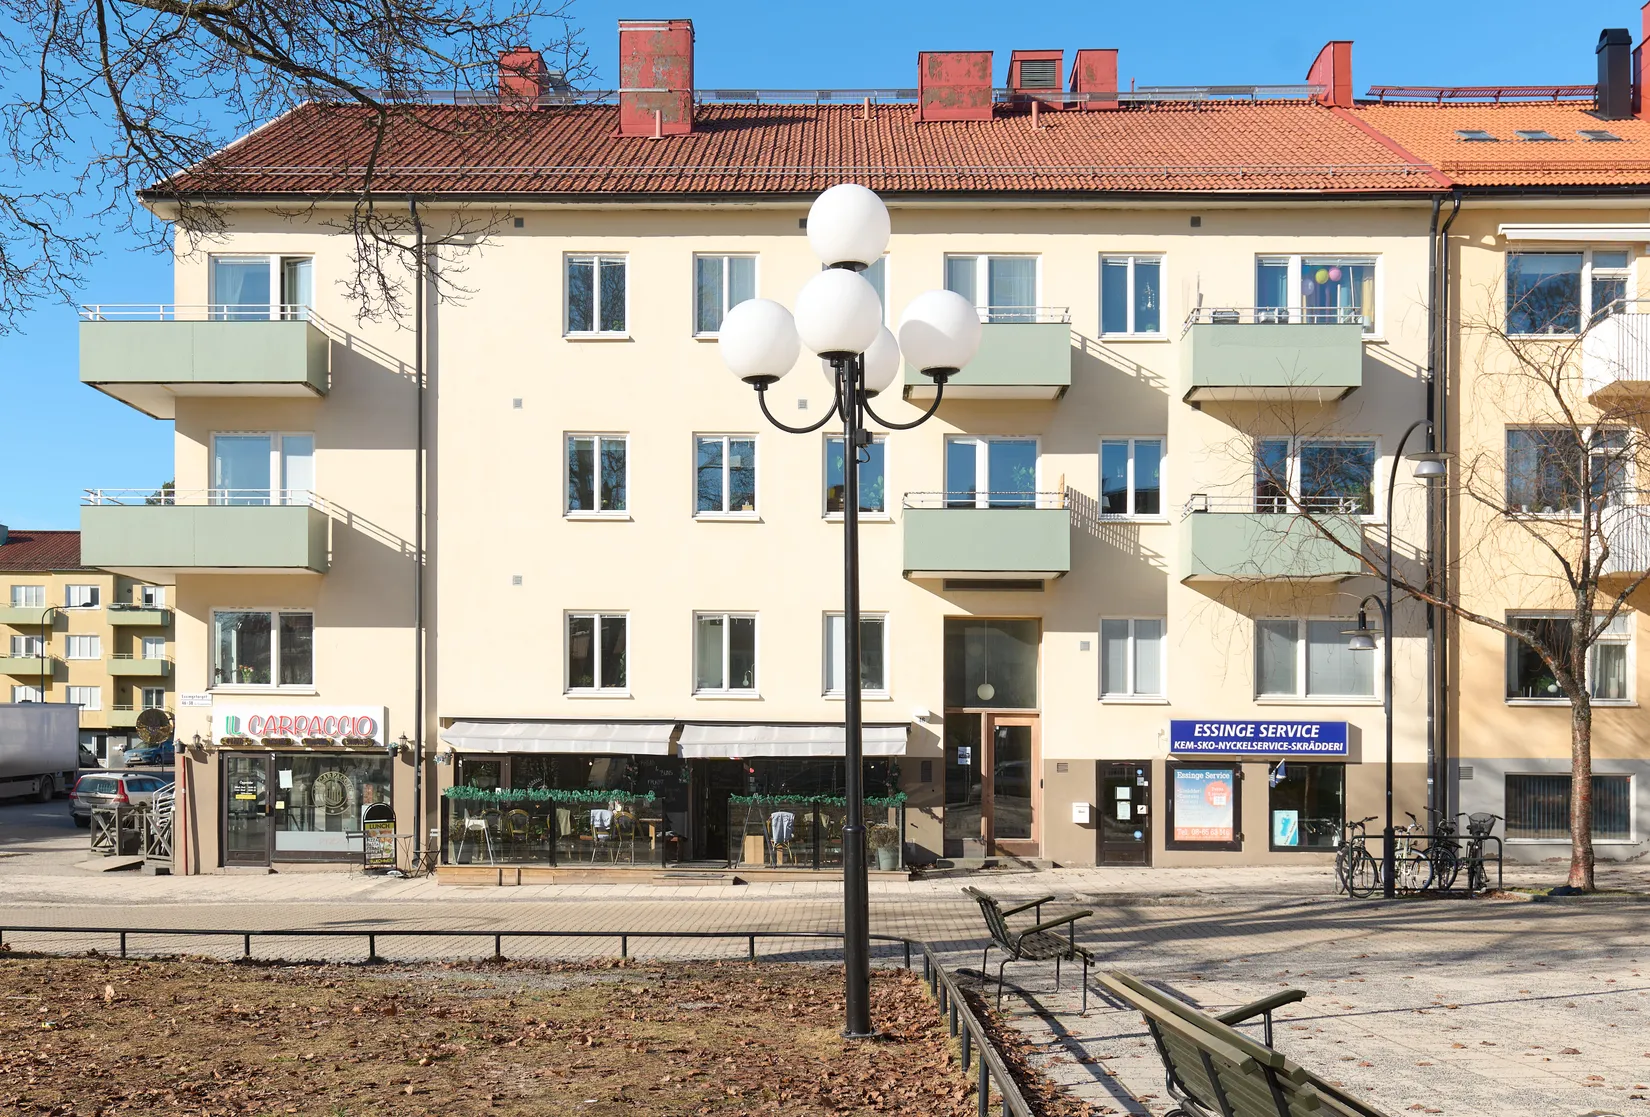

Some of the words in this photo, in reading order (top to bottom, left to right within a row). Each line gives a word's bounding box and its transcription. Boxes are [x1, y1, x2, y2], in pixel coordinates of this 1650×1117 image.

[225, 715, 242, 735] IL
[248, 715, 373, 736] CARPACCIO
[1193, 723, 1256, 738] ESSINGE
[1258, 724, 1320, 738] SERVICE
[1174, 740, 1344, 751] KEM-SKO-NYCKELSERVICE-SKRÄDDERI
[1177, 771, 1204, 780] Essinge
[1205, 771, 1230, 779] Service
